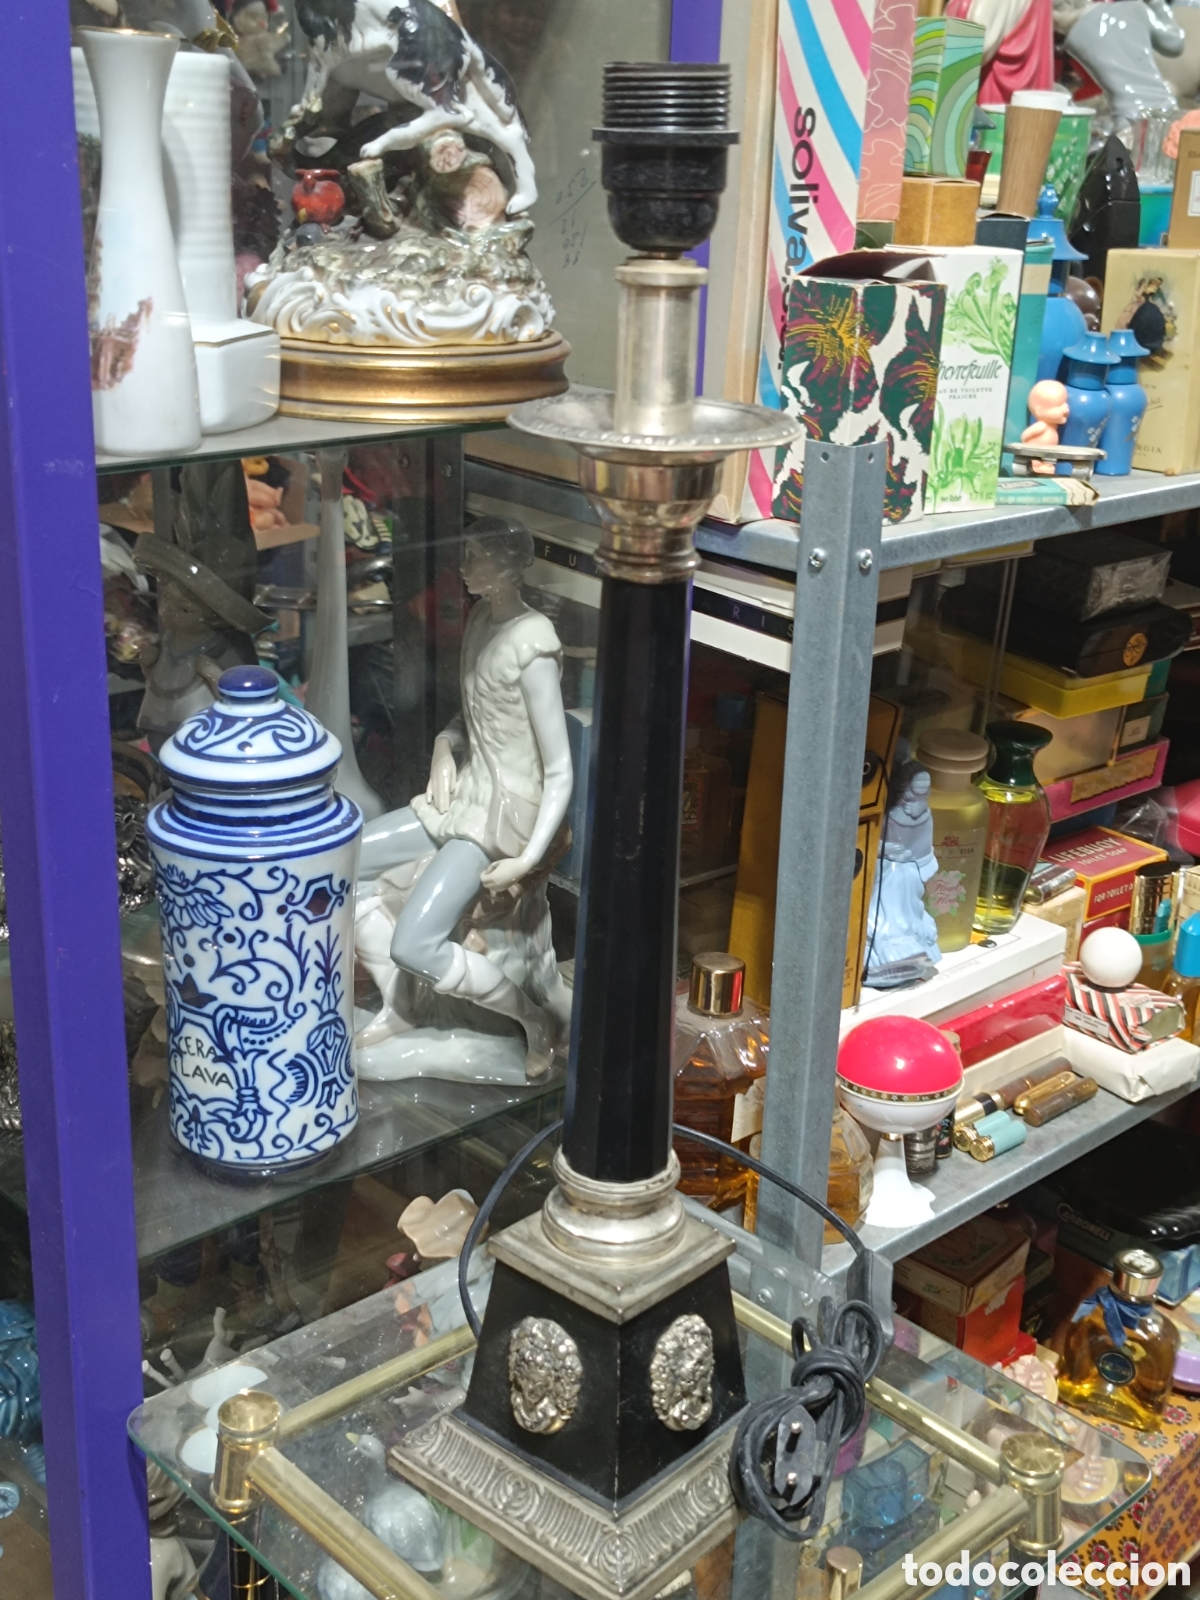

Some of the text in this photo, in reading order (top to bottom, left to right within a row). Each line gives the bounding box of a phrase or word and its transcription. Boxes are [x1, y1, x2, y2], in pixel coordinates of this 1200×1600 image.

[1048, 837, 1122, 863] LIFEBUOY
[1078, 847, 1128, 866] TOILET SOAP
[1093, 892, 1106, 904] FOR
[1106, 884, 1129, 899] TOILET
[178, 1036, 218, 1059] CERA
[1056, 1203, 1111, 1241] CARBONELL
